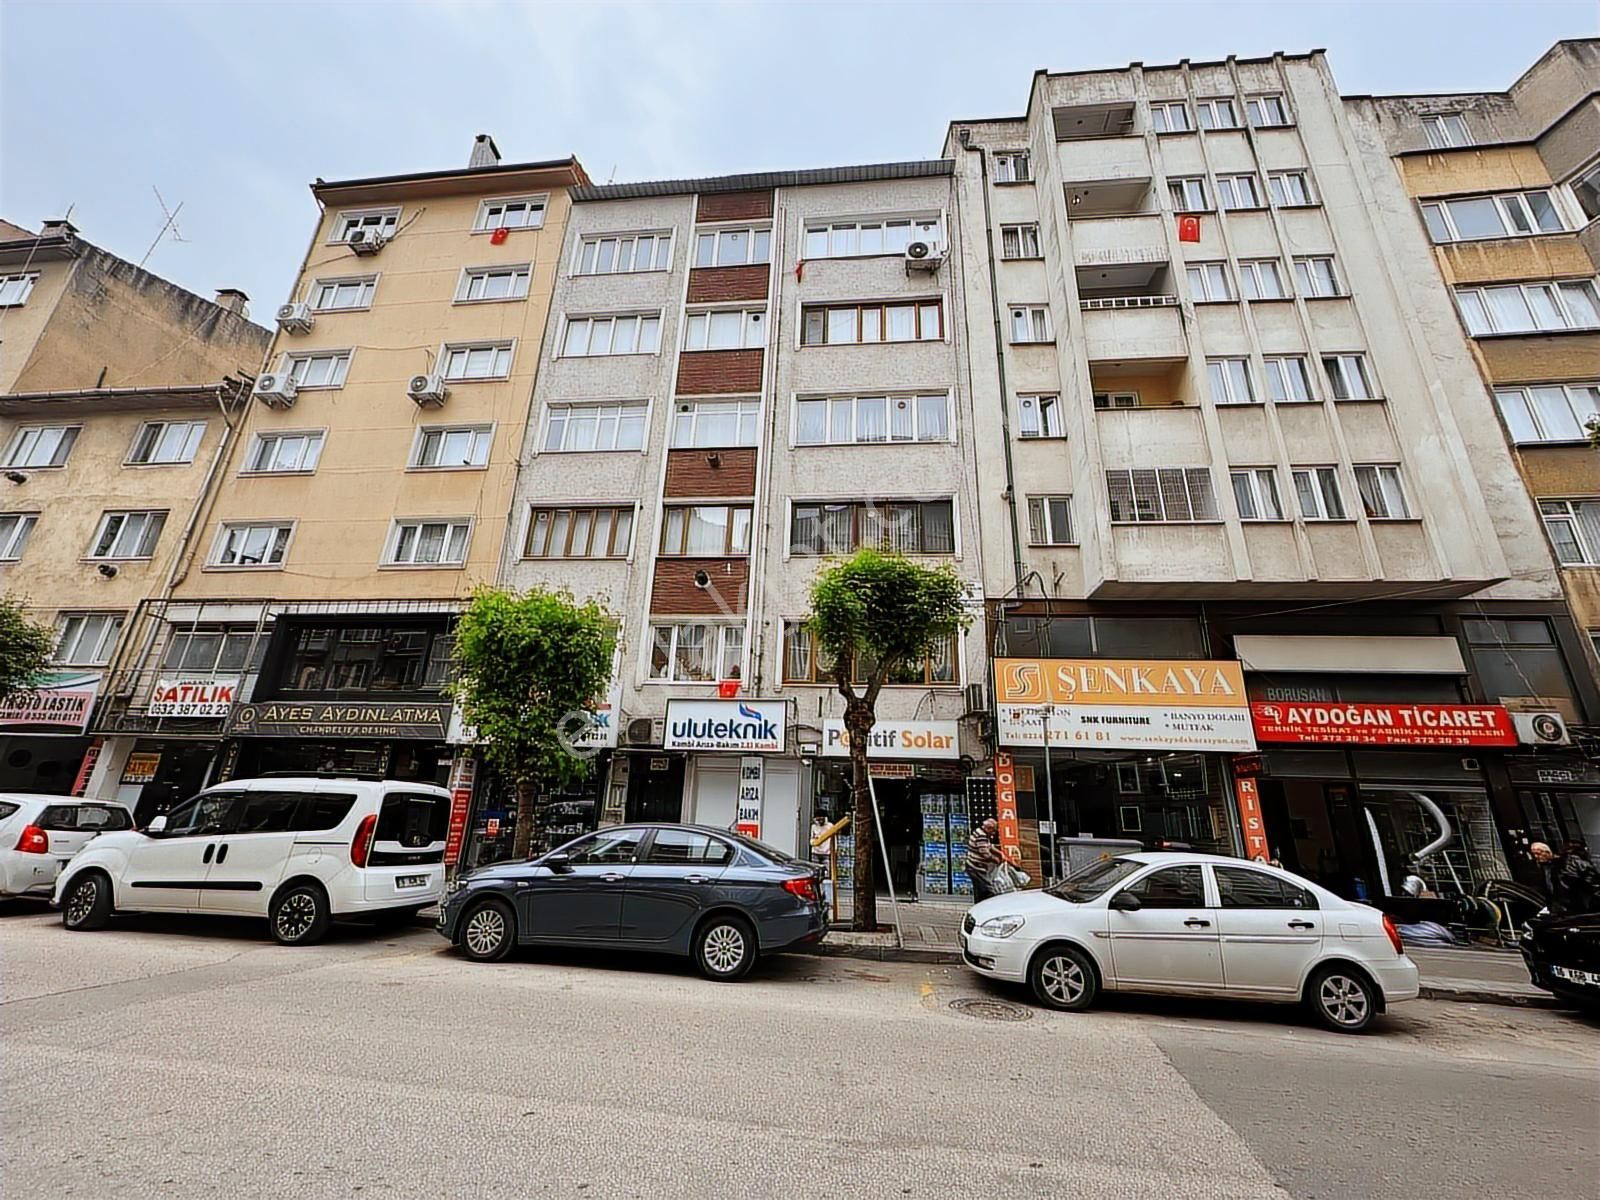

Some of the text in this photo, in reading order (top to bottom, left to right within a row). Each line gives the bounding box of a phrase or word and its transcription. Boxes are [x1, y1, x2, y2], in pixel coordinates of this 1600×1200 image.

[1056, 664, 1236, 701] ŞENKAYA
[154, 686, 235, 703] SATILIK
[177, 703, 198, 716] 387
[199, 703, 214, 716] 02
[263, 705, 441, 722] AYES AYDINLATMA
[1287, 705, 1496, 728] AYDOĞAN TİCARET
[672, 718, 777, 740] uluteknik
[828, 728, 954, 749] Pitif Solar
[1046, 730, 1068, 740] 271
[1074, 731, 1089, 741] 61
[1095, 731, 1110, 741] 81
